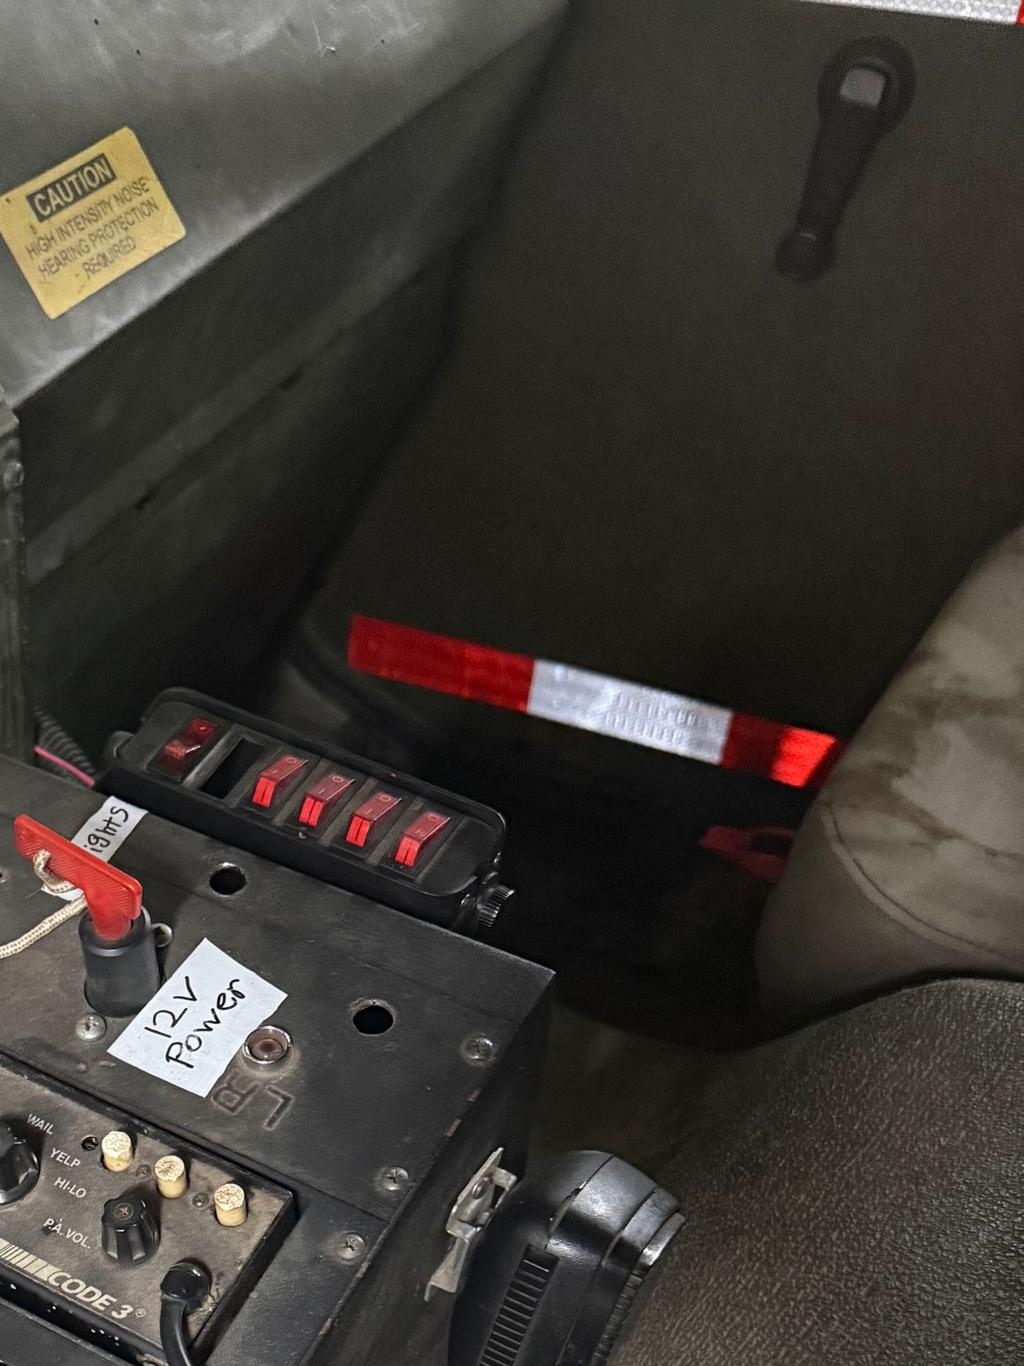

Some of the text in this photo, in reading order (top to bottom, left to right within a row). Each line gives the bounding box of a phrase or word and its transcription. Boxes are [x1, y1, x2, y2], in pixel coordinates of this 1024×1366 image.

[34, 157, 114, 217] CAUTION
[24, 176, 150, 261] HIGH INTENSITY NOISE
[37, 197, 160, 280] HEARING PROTECTION
[81, 236, 137, 280] REQUIRED
[84, 805, 130, 854] ights
[165, 977, 246, 1070] Power
[26, 1113, 56, 1136] WAIL
[49, 1148, 81, 1168] YELP
[47, 1271, 118, 1315] CODE
